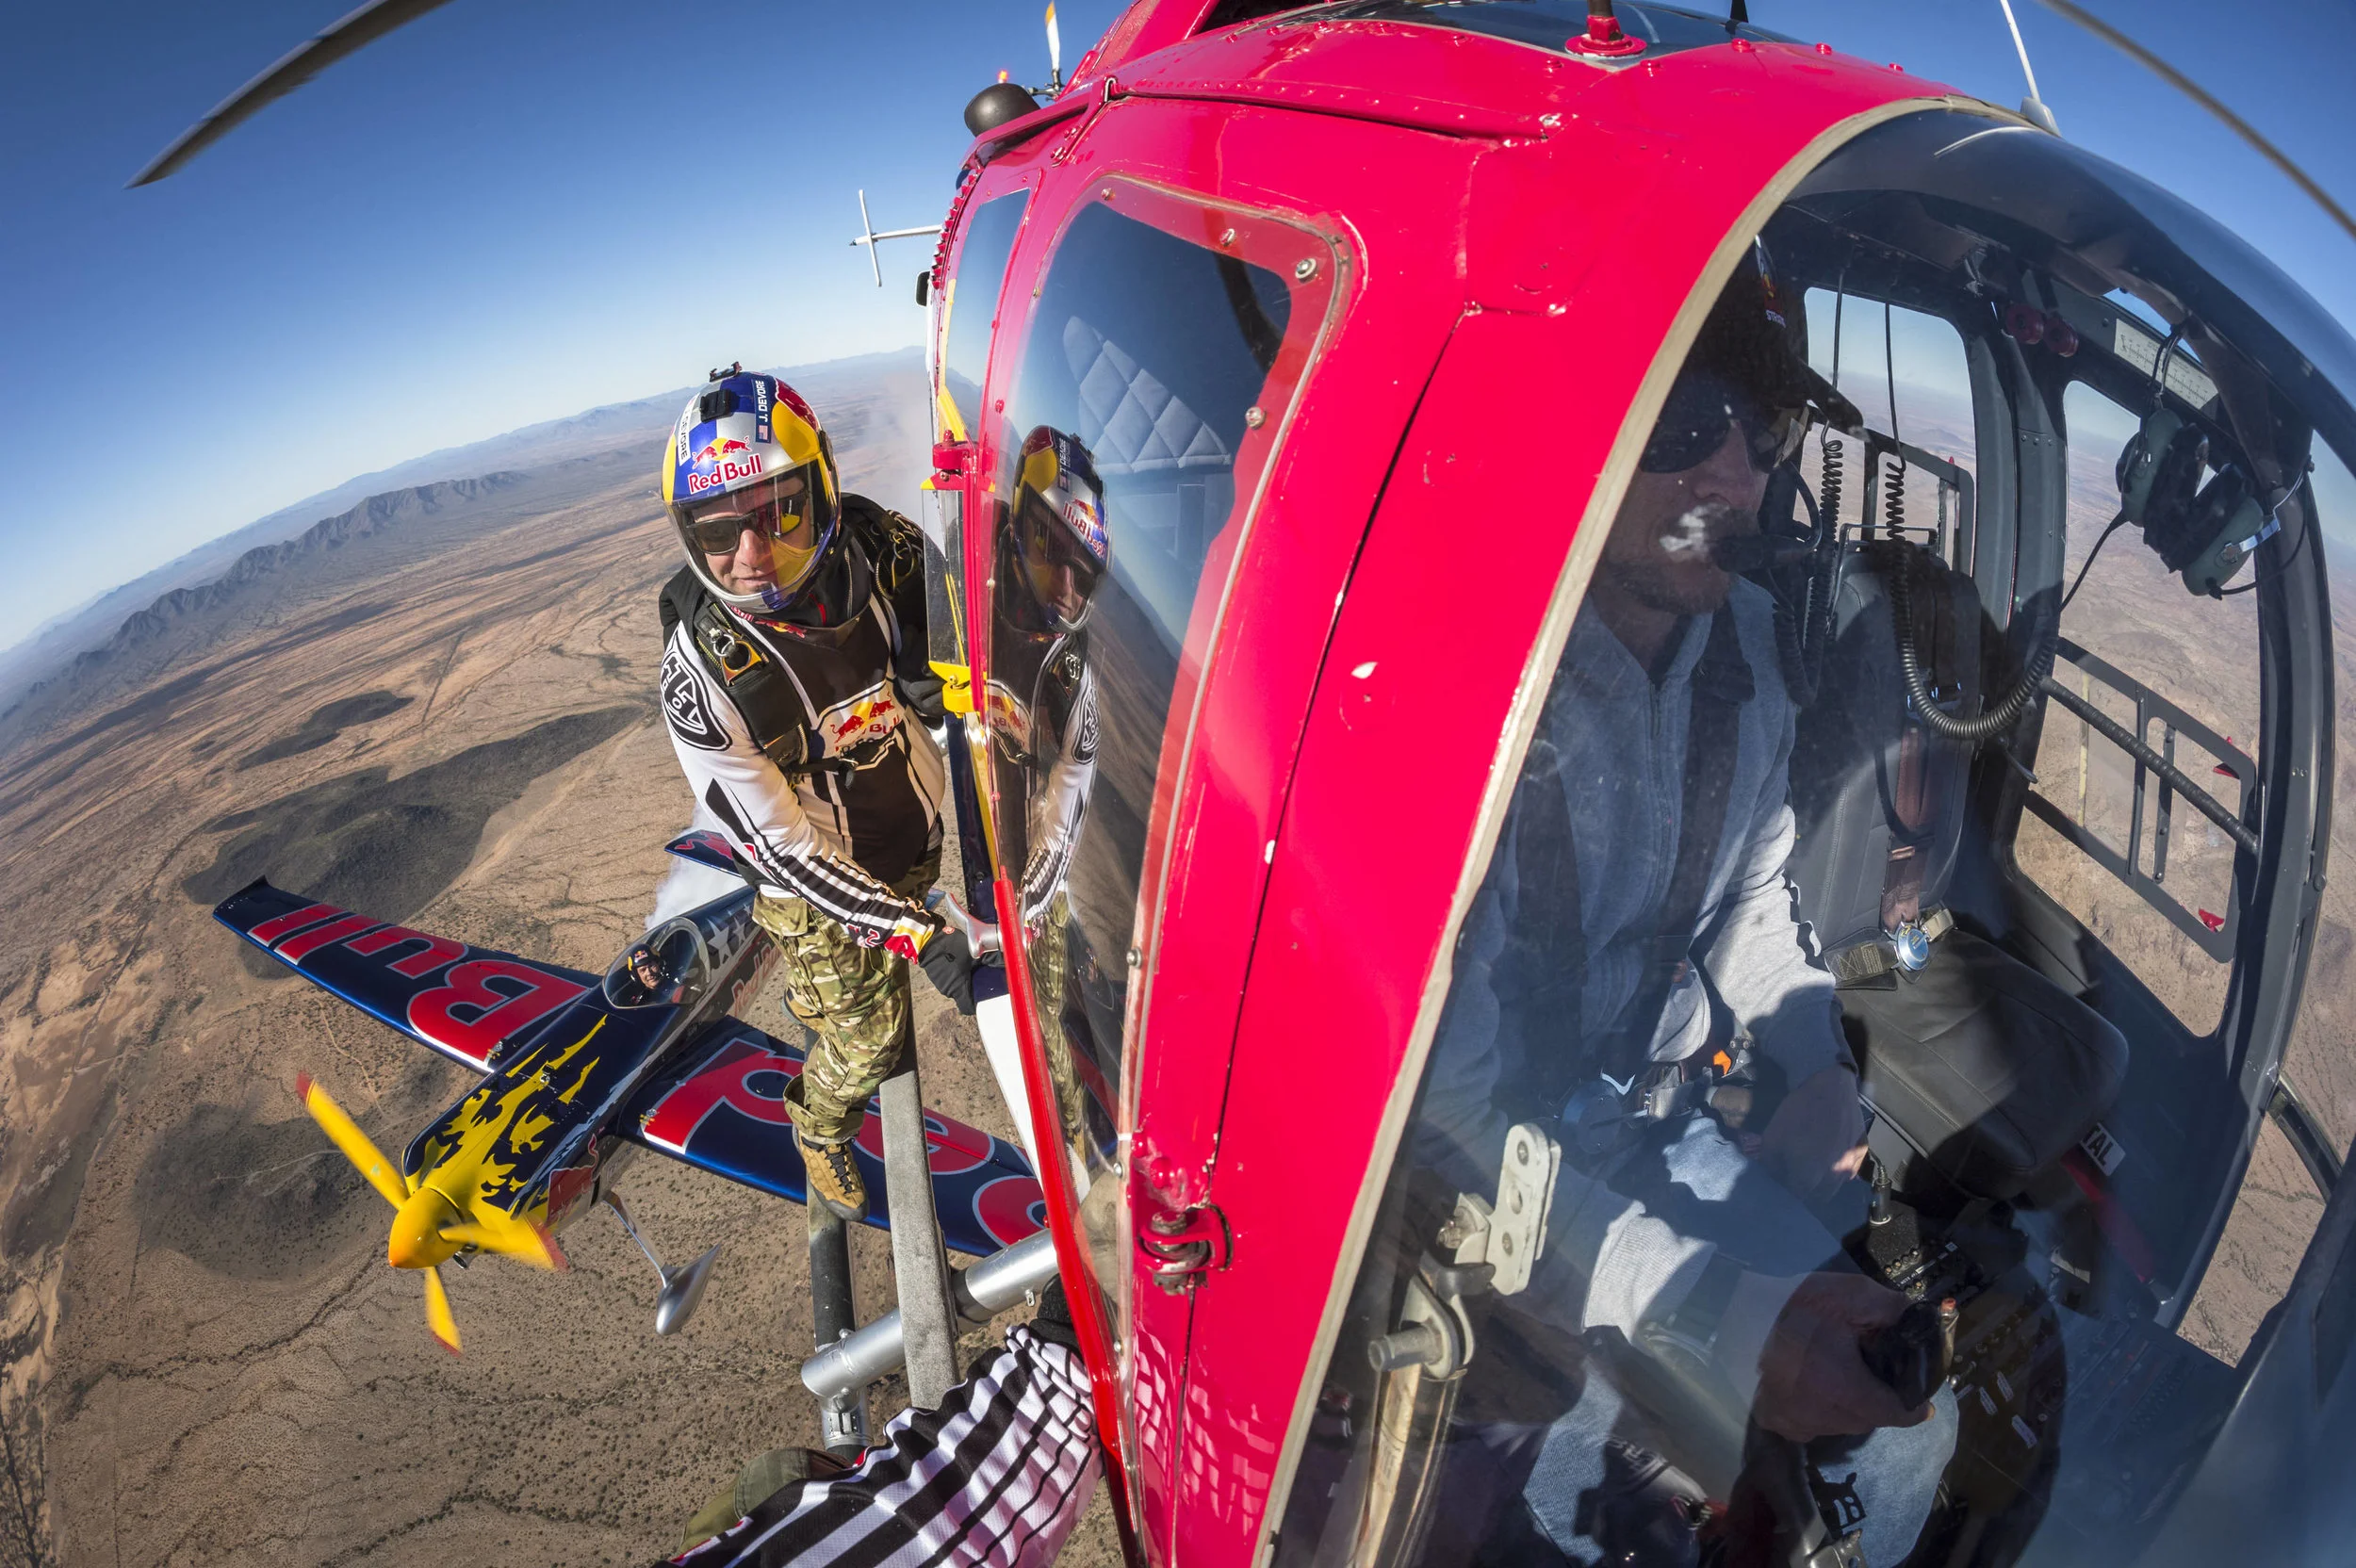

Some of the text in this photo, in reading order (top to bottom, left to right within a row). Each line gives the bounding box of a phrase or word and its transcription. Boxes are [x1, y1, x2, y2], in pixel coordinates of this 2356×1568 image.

[755, 380, 768, 423] J. DEVORE
[688, 454, 762, 494] Red Bull
[247, 902, 592, 1072] Bull
